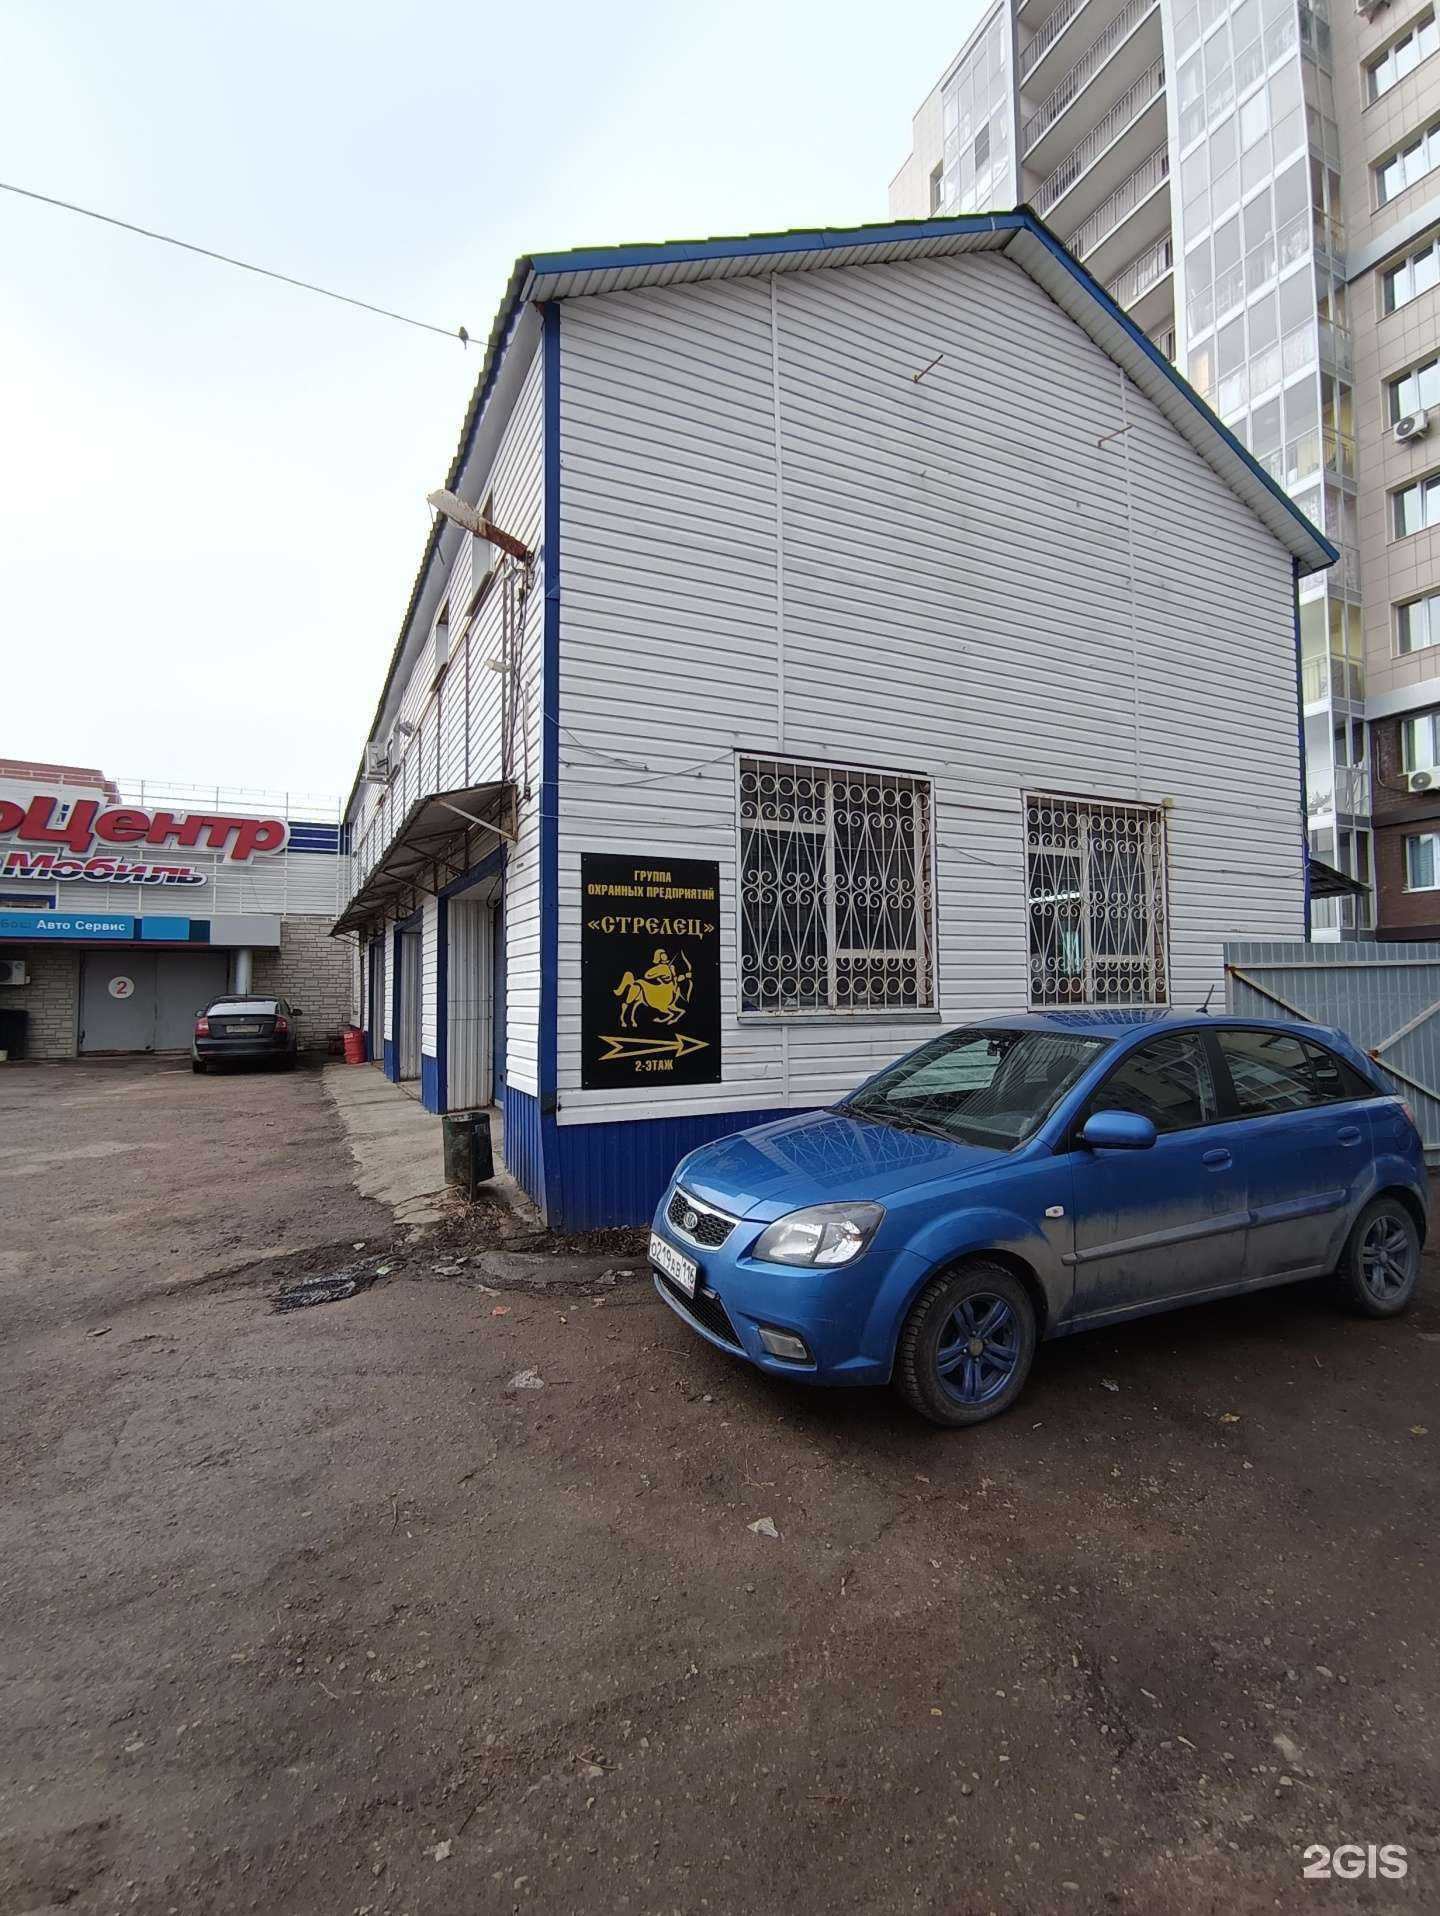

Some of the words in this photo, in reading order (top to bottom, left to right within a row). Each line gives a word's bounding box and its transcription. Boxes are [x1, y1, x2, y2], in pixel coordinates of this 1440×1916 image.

[634, 870, 672, 883] ГРУППА
[588, 884, 644, 898] ОХРАННЫХ
[646, 886, 715, 901] ПРЕДПРИЯТИЙ
[37, 919, 71, 930] Авто
[75, 921, 126, 933] Сервис
[587, 915, 715, 940] «СТРЕЛЕЦ»
[116, 980, 127, 994] 2
[635, 1060, 674, 1073] 2-ЭТАЖ
